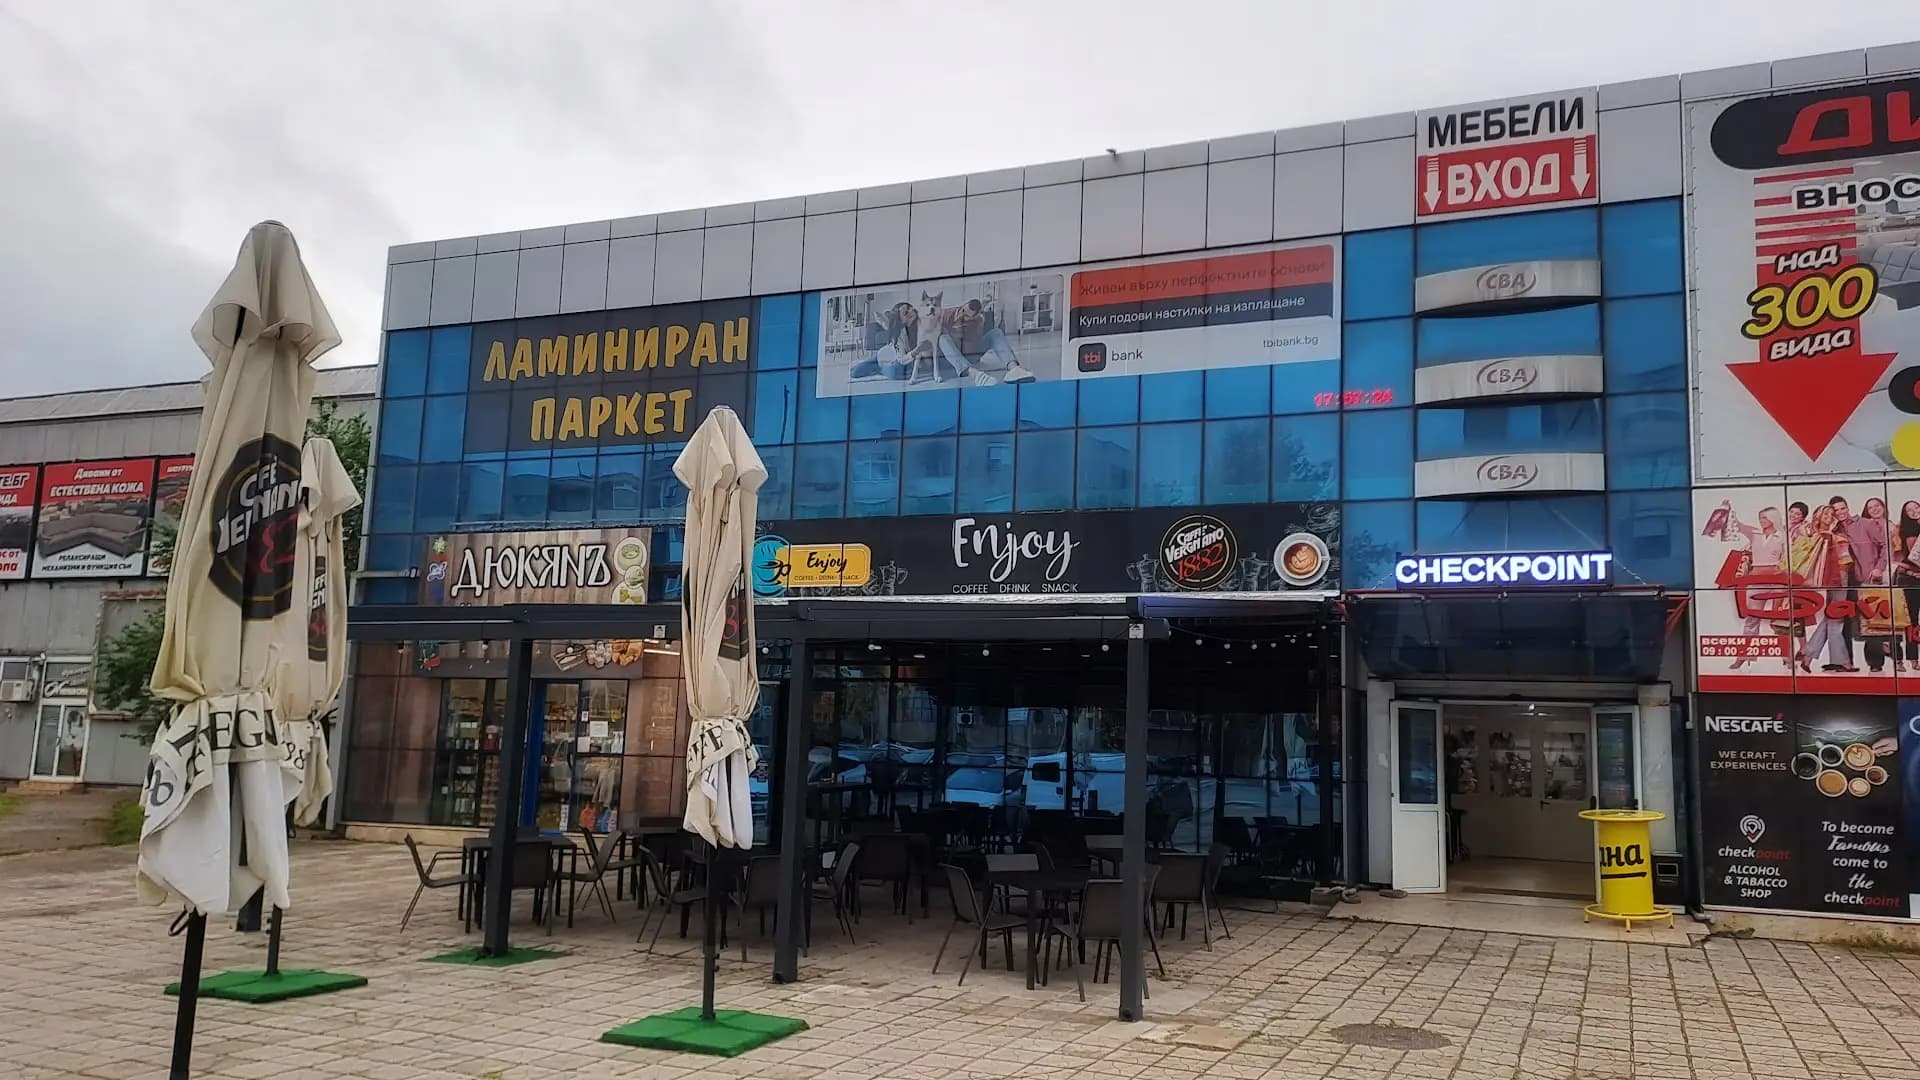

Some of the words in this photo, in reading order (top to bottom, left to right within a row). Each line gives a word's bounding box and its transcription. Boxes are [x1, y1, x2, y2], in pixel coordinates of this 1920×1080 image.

[1428, 97, 1584, 148] МЕБЕЛИ
[1447, 153, 1560, 205] ВХОД
[1777, 245, 1838, 274] над
[1744, 266, 1876, 338] 300
[1079, 315, 1107, 327] Купи
[1109, 311, 1152, 325] подови
[1155, 304, 1213, 319] настилки
[1215, 303, 1231, 314] на
[1233, 296, 1306, 313] изплащане
[483, 317, 749, 382] ЛАМИНИРАН
[1263, 335, 1319, 348] tbibank.bg
[1770, 329, 1853, 361] вида
[1111, 348, 1144, 362] bank
[530, 389, 693, 441] ПАРКЕТ
[50, 485, 111, 497] ЕСТЕСТВЕНА
[111, 482, 144, 494] КОЖА
[952, 518, 1081, 582] Enjoy
[807, 552, 847, 573] Enjoy
[1395, 553, 1612, 583] CHECKPOINT
[952, 584, 988, 593] COFFEE
[1000, 584, 1031, 592] DRINK
[1041, 583, 1078, 592] SNACK
[1750, 638, 1778, 646] ден
[1705, 713, 1784, 733] NESCAFÉ
[1740, 751, 1776, 759] CRAFT
[1710, 761, 1787, 771] EXPERIENCES
[1822, 821, 1837, 832] To
[1840, 821, 1894, 835] become
[1827, 835, 1891, 853] Famous
[1729, 864, 1781, 876] ALCOHOL
[1832, 857, 1870, 868] come
[1873, 858, 1888, 869] to
[1724, 875, 1733, 885] &
[1736, 877, 1788, 888] TABACCO
[1848, 873, 1875, 889] the
[1740, 888, 1772, 898] SHOP
[1824, 891, 1900, 907] checkpoint
